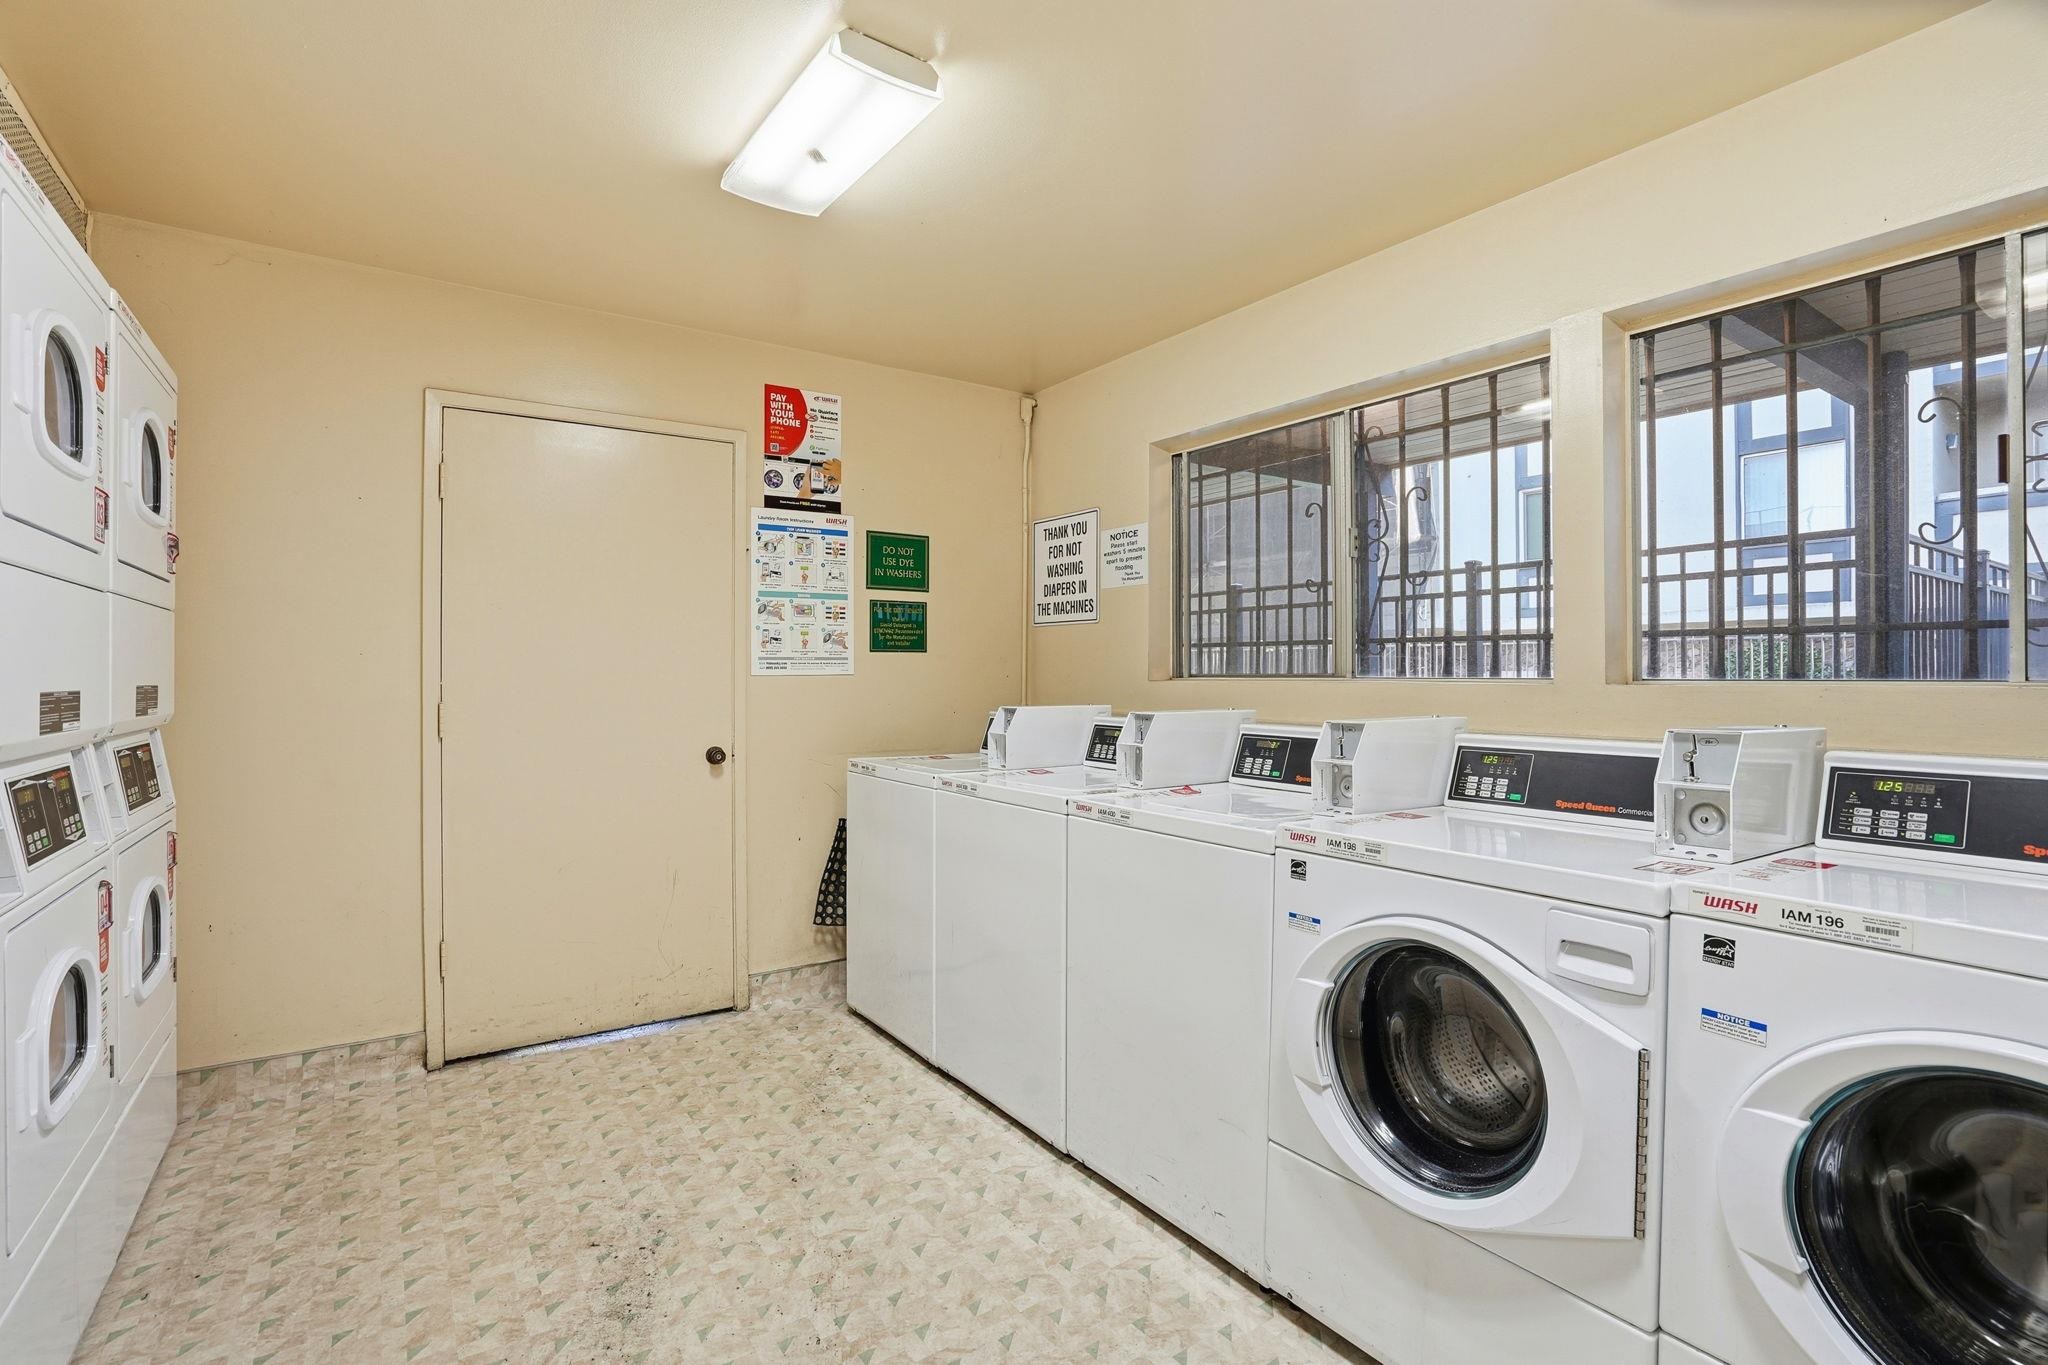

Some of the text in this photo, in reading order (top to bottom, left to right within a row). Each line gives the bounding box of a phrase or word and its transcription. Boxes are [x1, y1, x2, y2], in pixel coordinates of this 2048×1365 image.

[770, 393, 787, 402] PAY
[770, 401, 793, 411] WITH
[770, 409, 795, 419] YOUR
[770, 417, 801, 428] PHONE
[826, 517, 847, 526] WASH
[1043, 521, 1087, 541] THANK YOU
[1110, 530, 1138, 541] NOTICE
[882, 546, 914, 556] DO NOT
[1049, 541, 1082, 559] FOR NOT
[882, 557, 914, 568] USE DYE
[874, 568, 922, 578] IN WASHERS
[1047, 560, 1084, 578] WASHING
[1044, 580, 1087, 598] DIAPERS IN
[1037, 598, 1094, 616] THE MACHINES
[1556, 800, 1585, 810] Speed
[1586, 802, 1616, 813] Queen
[1290, 832, 1316, 844] WASH
[1326, 838, 1342, 848] IAM
[2023, 844, 2048, 858] Sp
[1704, 896, 1758, 914] WASH
[1782, 908, 1844, 928] IAM 196
[1722, 959, 1734, 968] STAR
[1717, 1012, 1751, 1027] NOTICE
